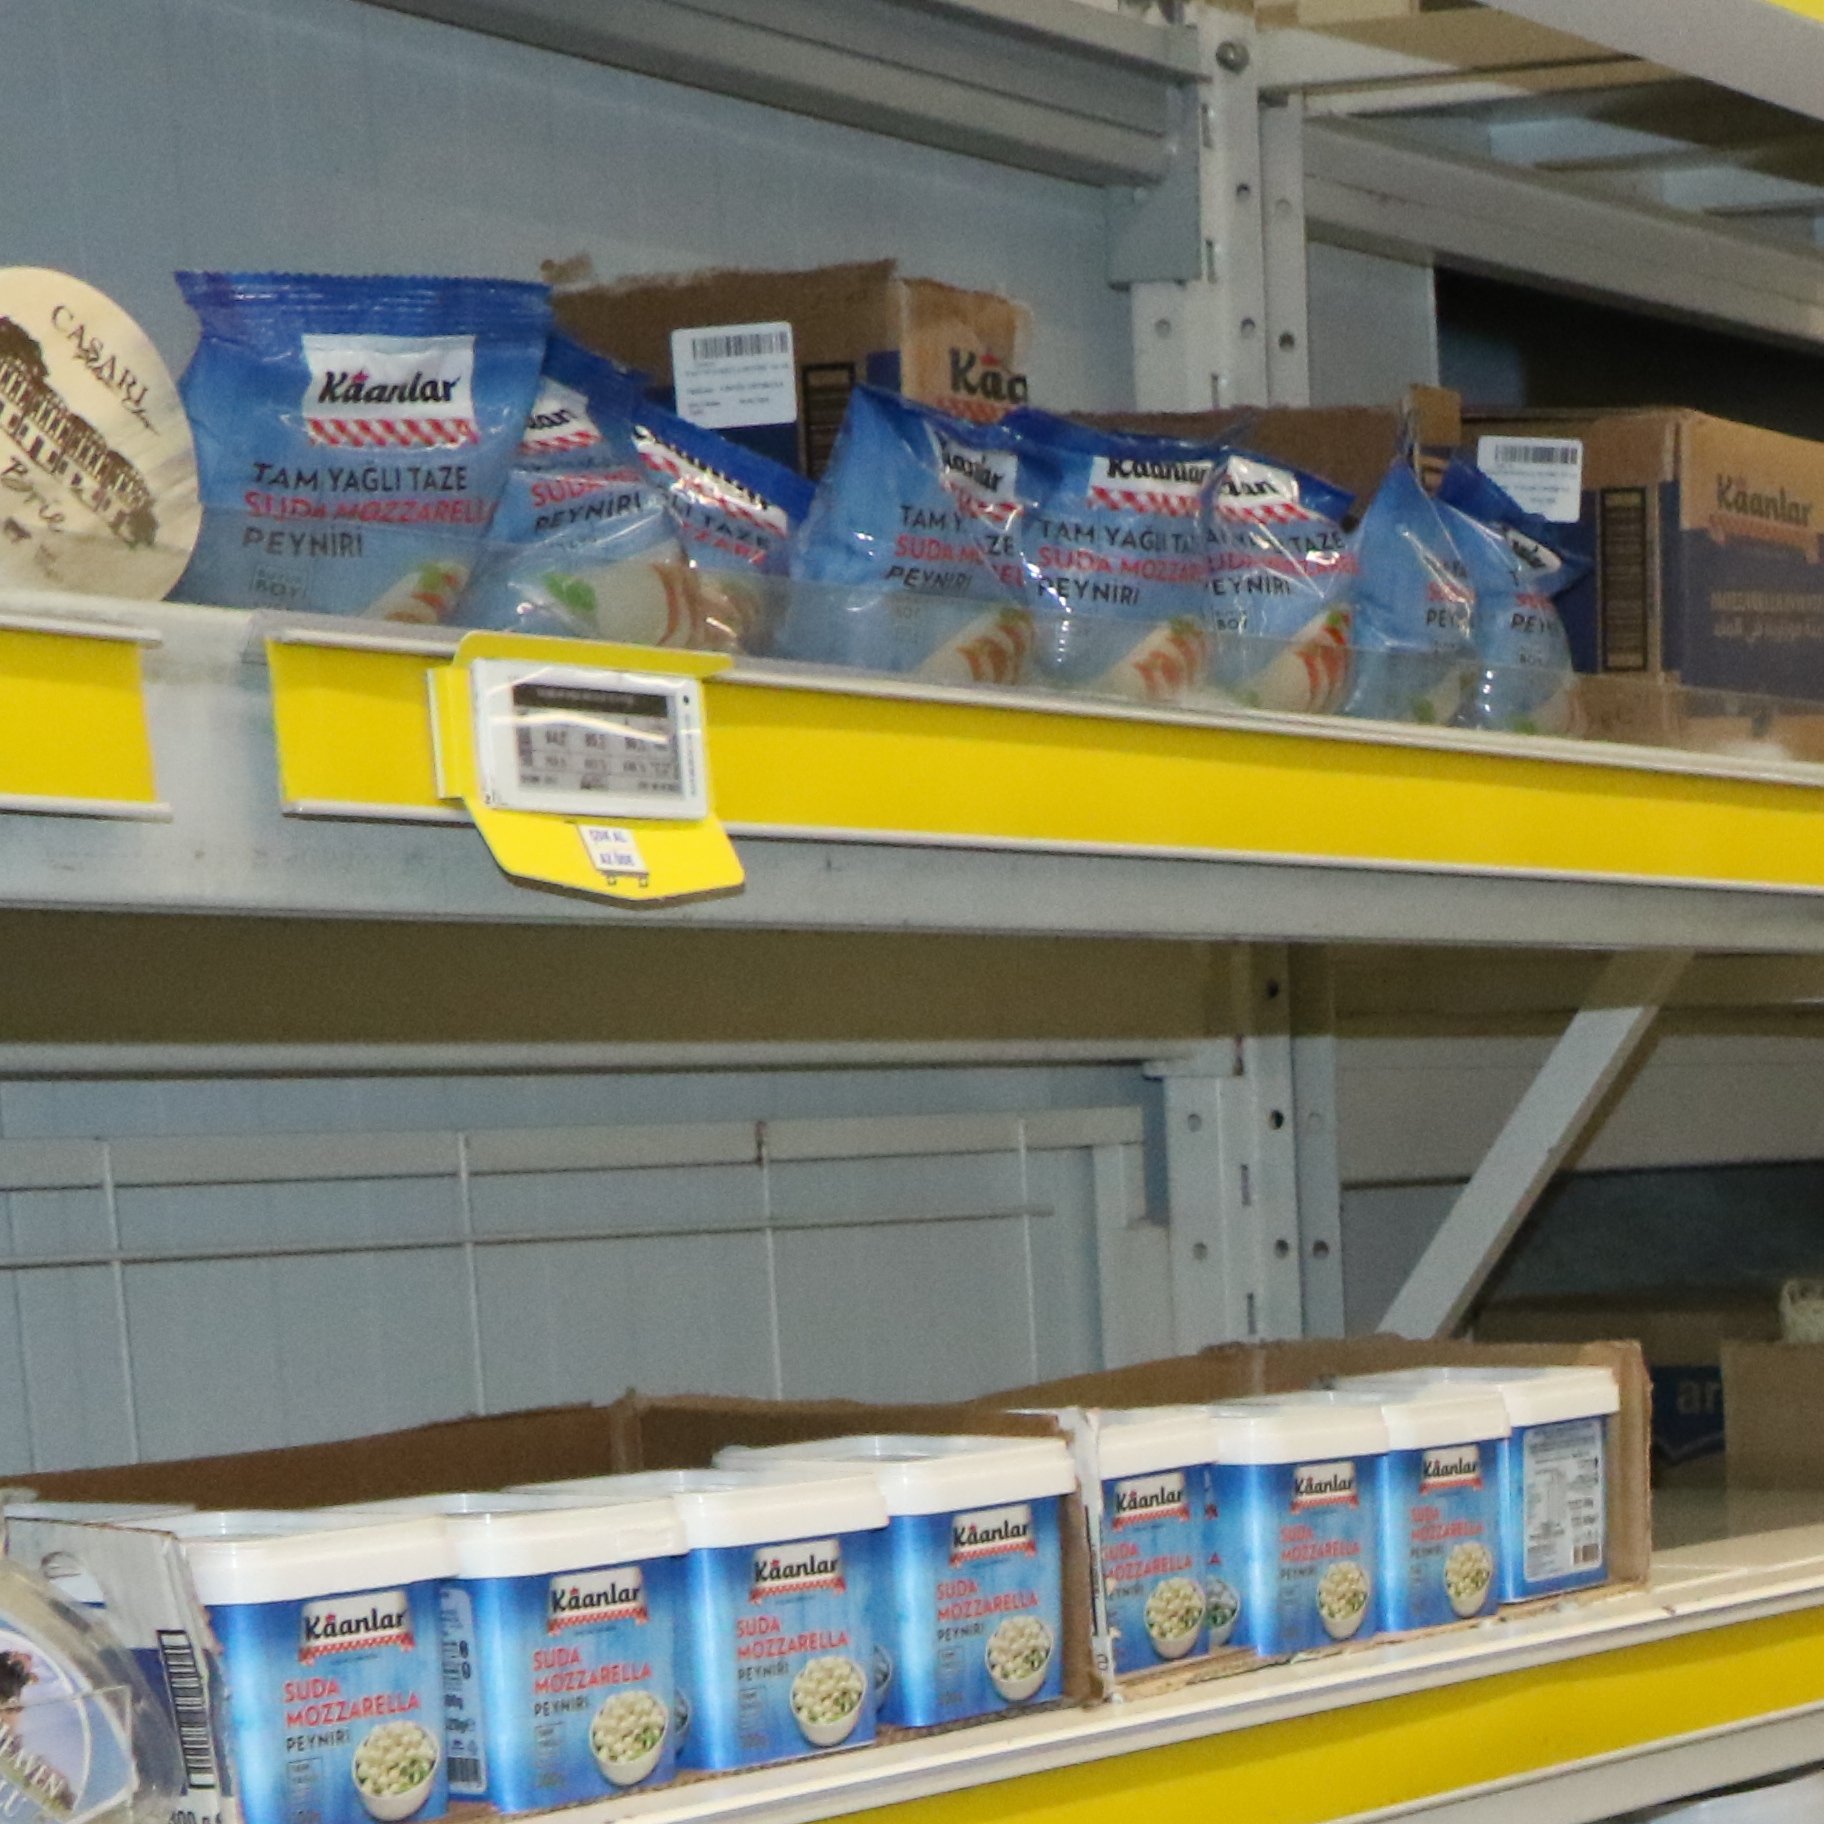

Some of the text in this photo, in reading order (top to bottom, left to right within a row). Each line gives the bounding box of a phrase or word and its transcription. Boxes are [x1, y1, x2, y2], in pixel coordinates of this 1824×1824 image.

[251, 461, 468, 491] TAM YAĞLI TAZE
[244, 491, 325, 523] SUDA
[1039, 519, 1096, 546] TAM
[1038, 546, 1113, 571] SUDA
[1410, 1521, 1484, 1542] MOZZARELLA
[1280, 1541, 1361, 1563] MOZZARELLA
[937, 1580, 978, 1600] SUDA
[937, 1593, 1039, 1621] MOZZARELLA
[736, 1616, 780, 1638] SUDA
[736, 1630, 849, 1660] MOZZARELLA
[532, 1646, 583, 1673] SUDA
[534, 1660, 653, 1693] MOZZARELLA
[283, 1678, 340, 1703] SUDA
[286, 1691, 421, 1728] MOZZARELLA
